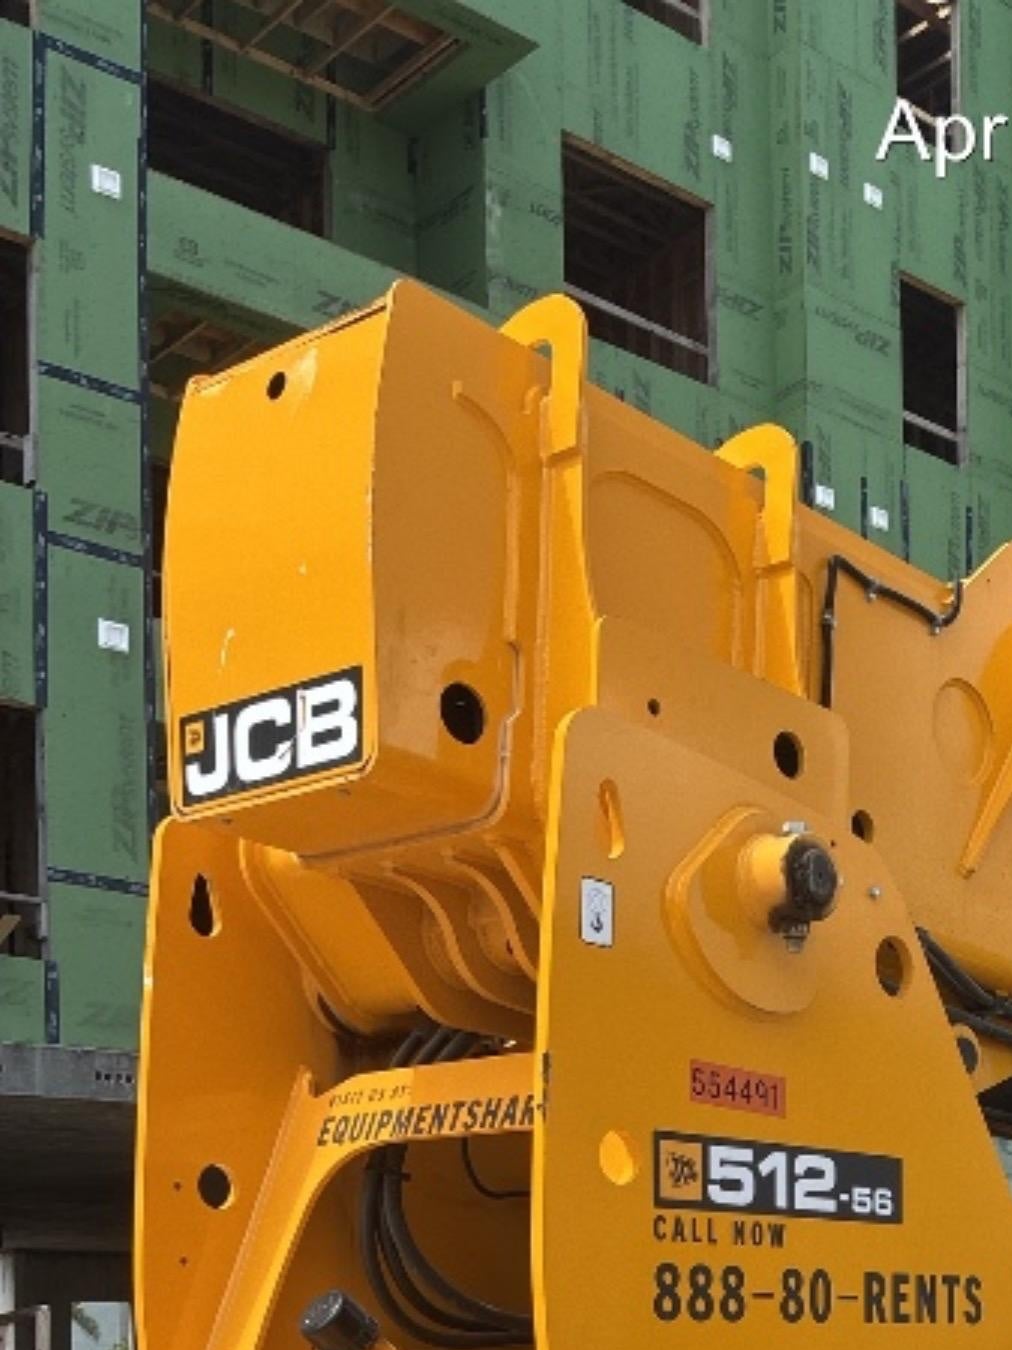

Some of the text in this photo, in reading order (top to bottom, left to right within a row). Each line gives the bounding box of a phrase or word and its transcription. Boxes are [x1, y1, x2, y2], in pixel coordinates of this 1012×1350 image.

[184, 678, 359, 797] JCB
[690, 1066, 780, 1111] 554491
[706, 1144, 894, 1217] 512-56
[653, 1214, 787, 1249] CALL NOW
[652, 1262, 983, 1325] 888-80-RENTS
